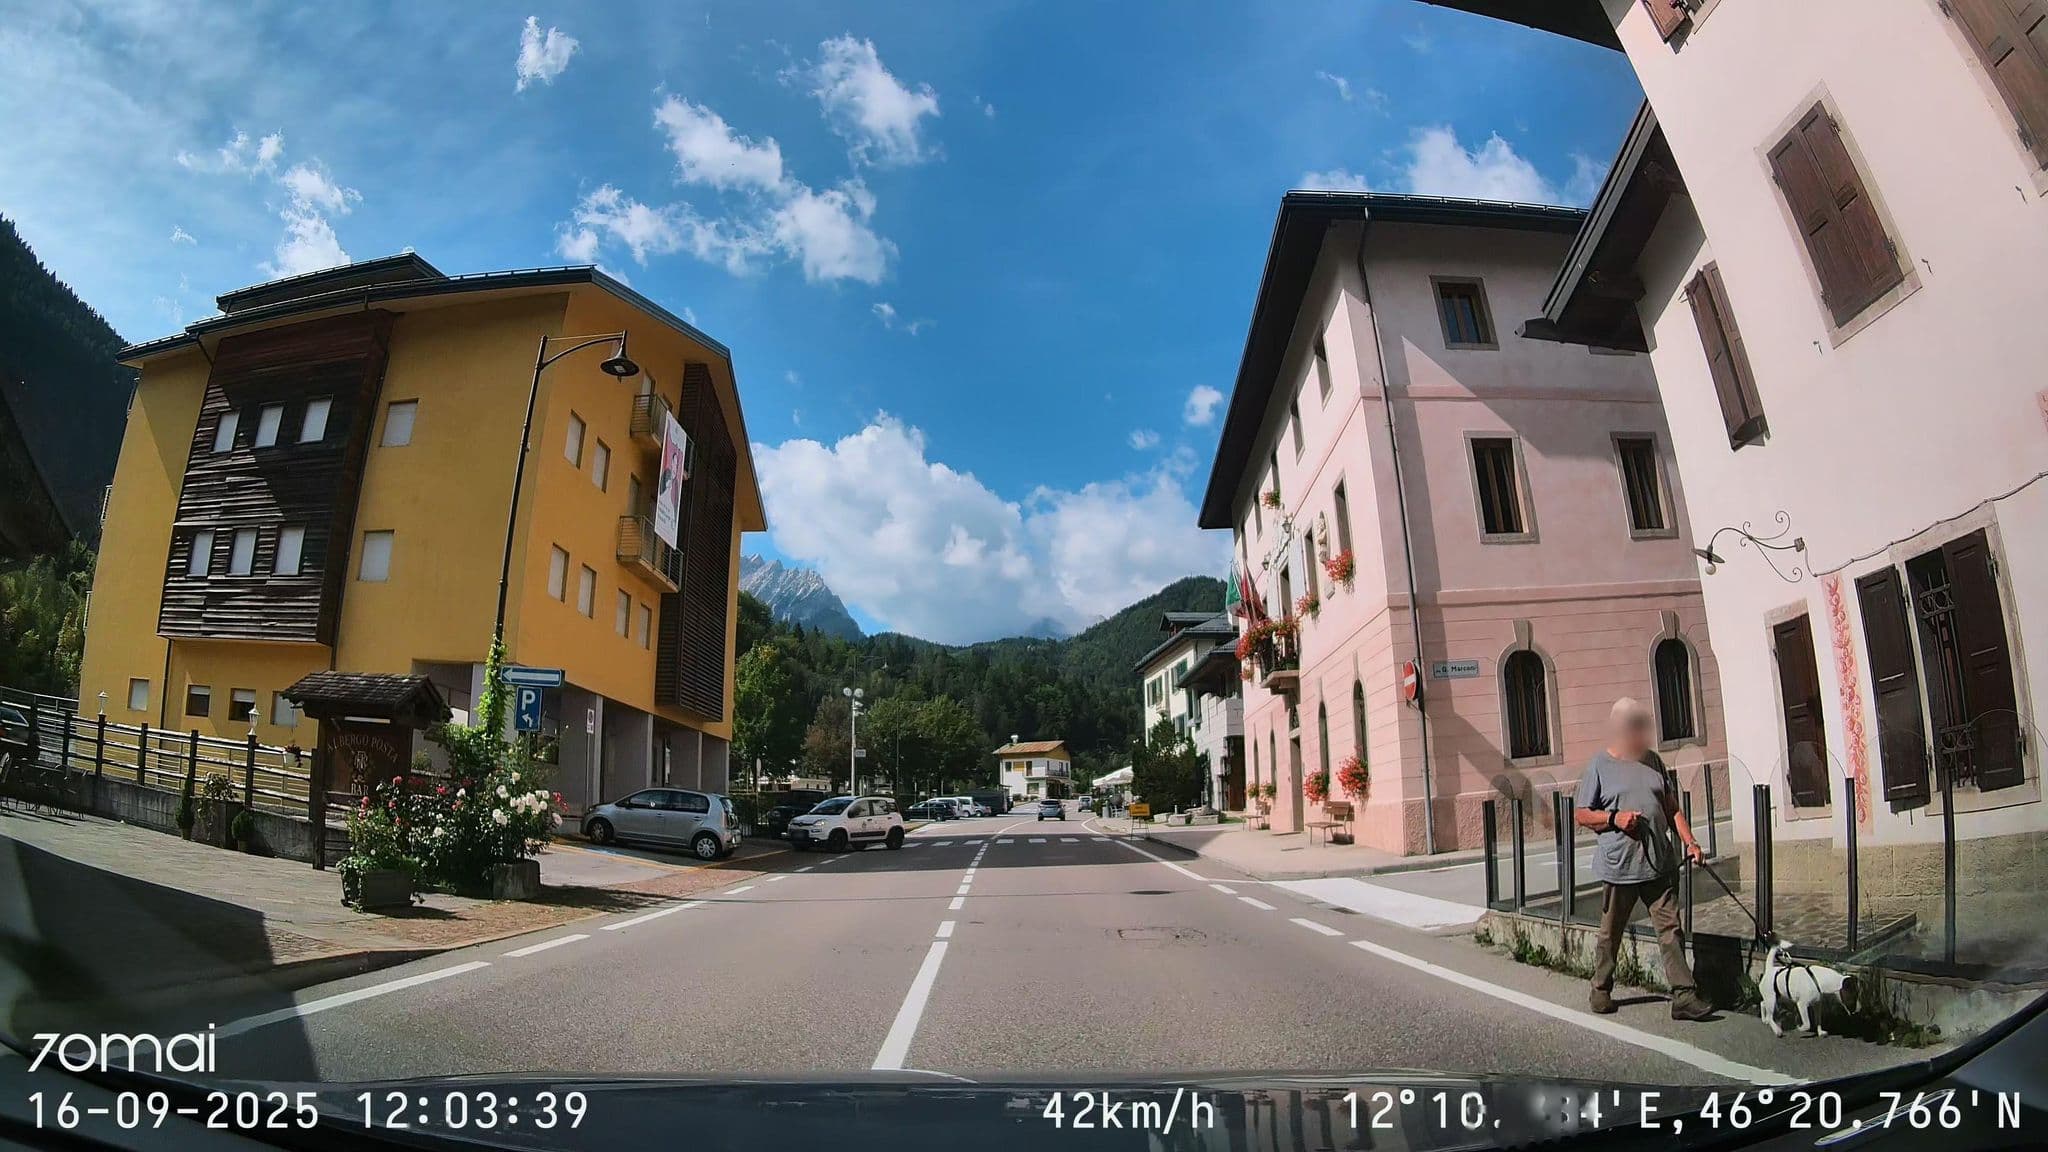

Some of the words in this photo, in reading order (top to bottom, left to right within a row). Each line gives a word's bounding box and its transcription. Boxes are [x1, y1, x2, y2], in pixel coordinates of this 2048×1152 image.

[521, 689, 536, 711] P
[327, 734, 369, 753] ALBERGO
[371, 735, 399, 763] POSTA
[350, 782, 369, 796] BAR
